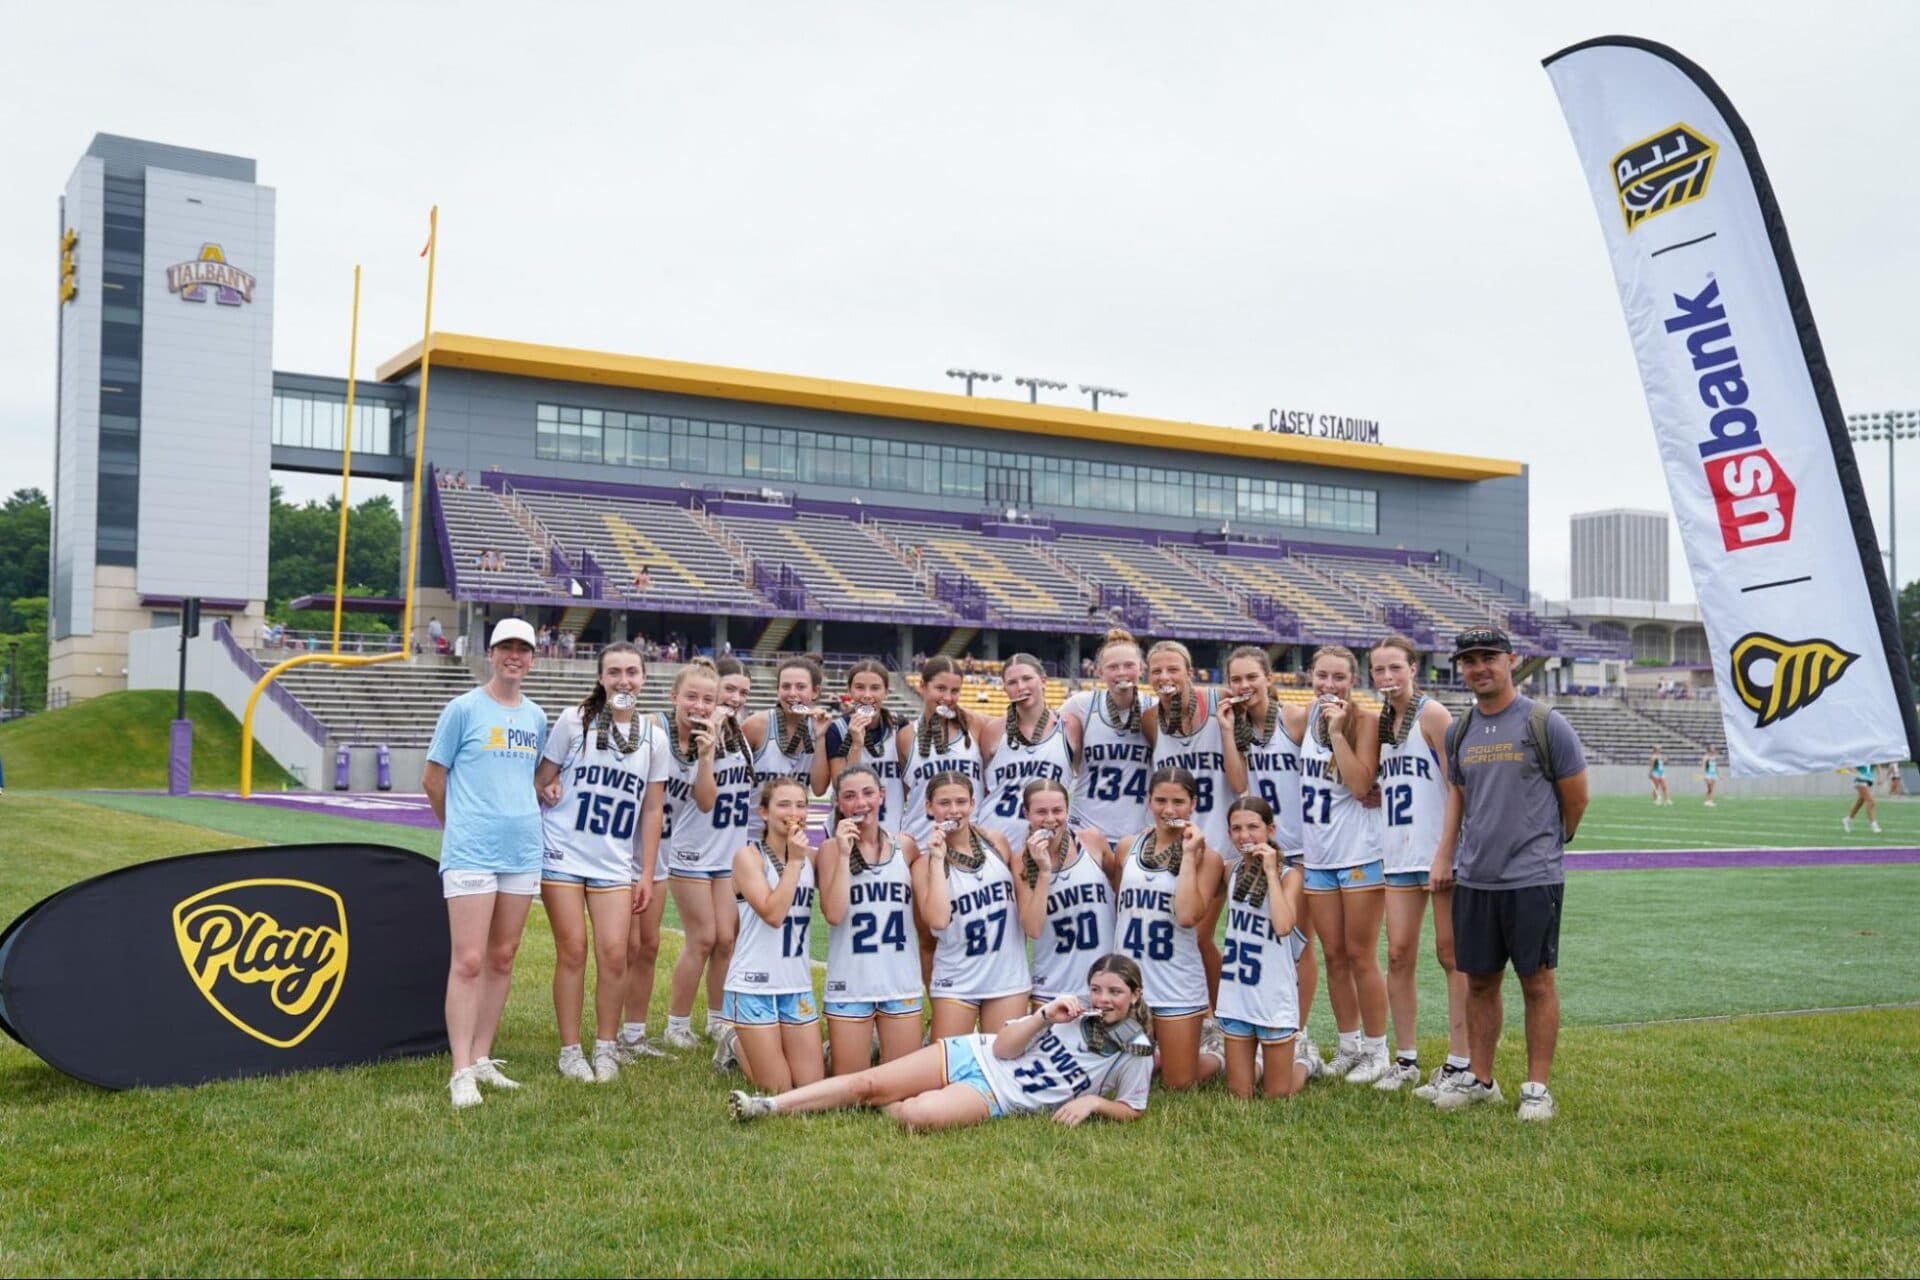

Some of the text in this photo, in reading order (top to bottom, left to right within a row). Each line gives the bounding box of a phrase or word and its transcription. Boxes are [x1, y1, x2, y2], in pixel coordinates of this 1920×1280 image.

[1617, 135, 1689, 188] PLL
[166, 260, 256, 303] UALBANY
[1269, 408, 1380, 443] CASEY STADIUM
[508, 728, 537, 750] POWE
[1084, 743, 1153, 767] POWER
[994, 760, 1063, 784] POWER
[1247, 752, 1300, 772] OWER
[573, 765, 645, 801] POWER
[995, 785, 1026, 819] 5
[1087, 766, 1147, 804] 134
[575, 791, 636, 840] 150
[712, 790, 750, 829] 65
[1302, 785, 1333, 824] 21
[1385, 784, 1413, 827] 12
[850, 881, 912, 906] OWER
[1046, 883, 1108, 915] OWER
[1119, 887, 1177, 915] POWE
[782, 915, 810, 958] 17
[852, 910, 907, 954] 24
[965, 908, 1007, 957] 87
[1052, 910, 1099, 954] 50
[1123, 917, 1174, 961] 48
[187, 909, 337, 1007] Play
[1220, 937, 1263, 987] 25
